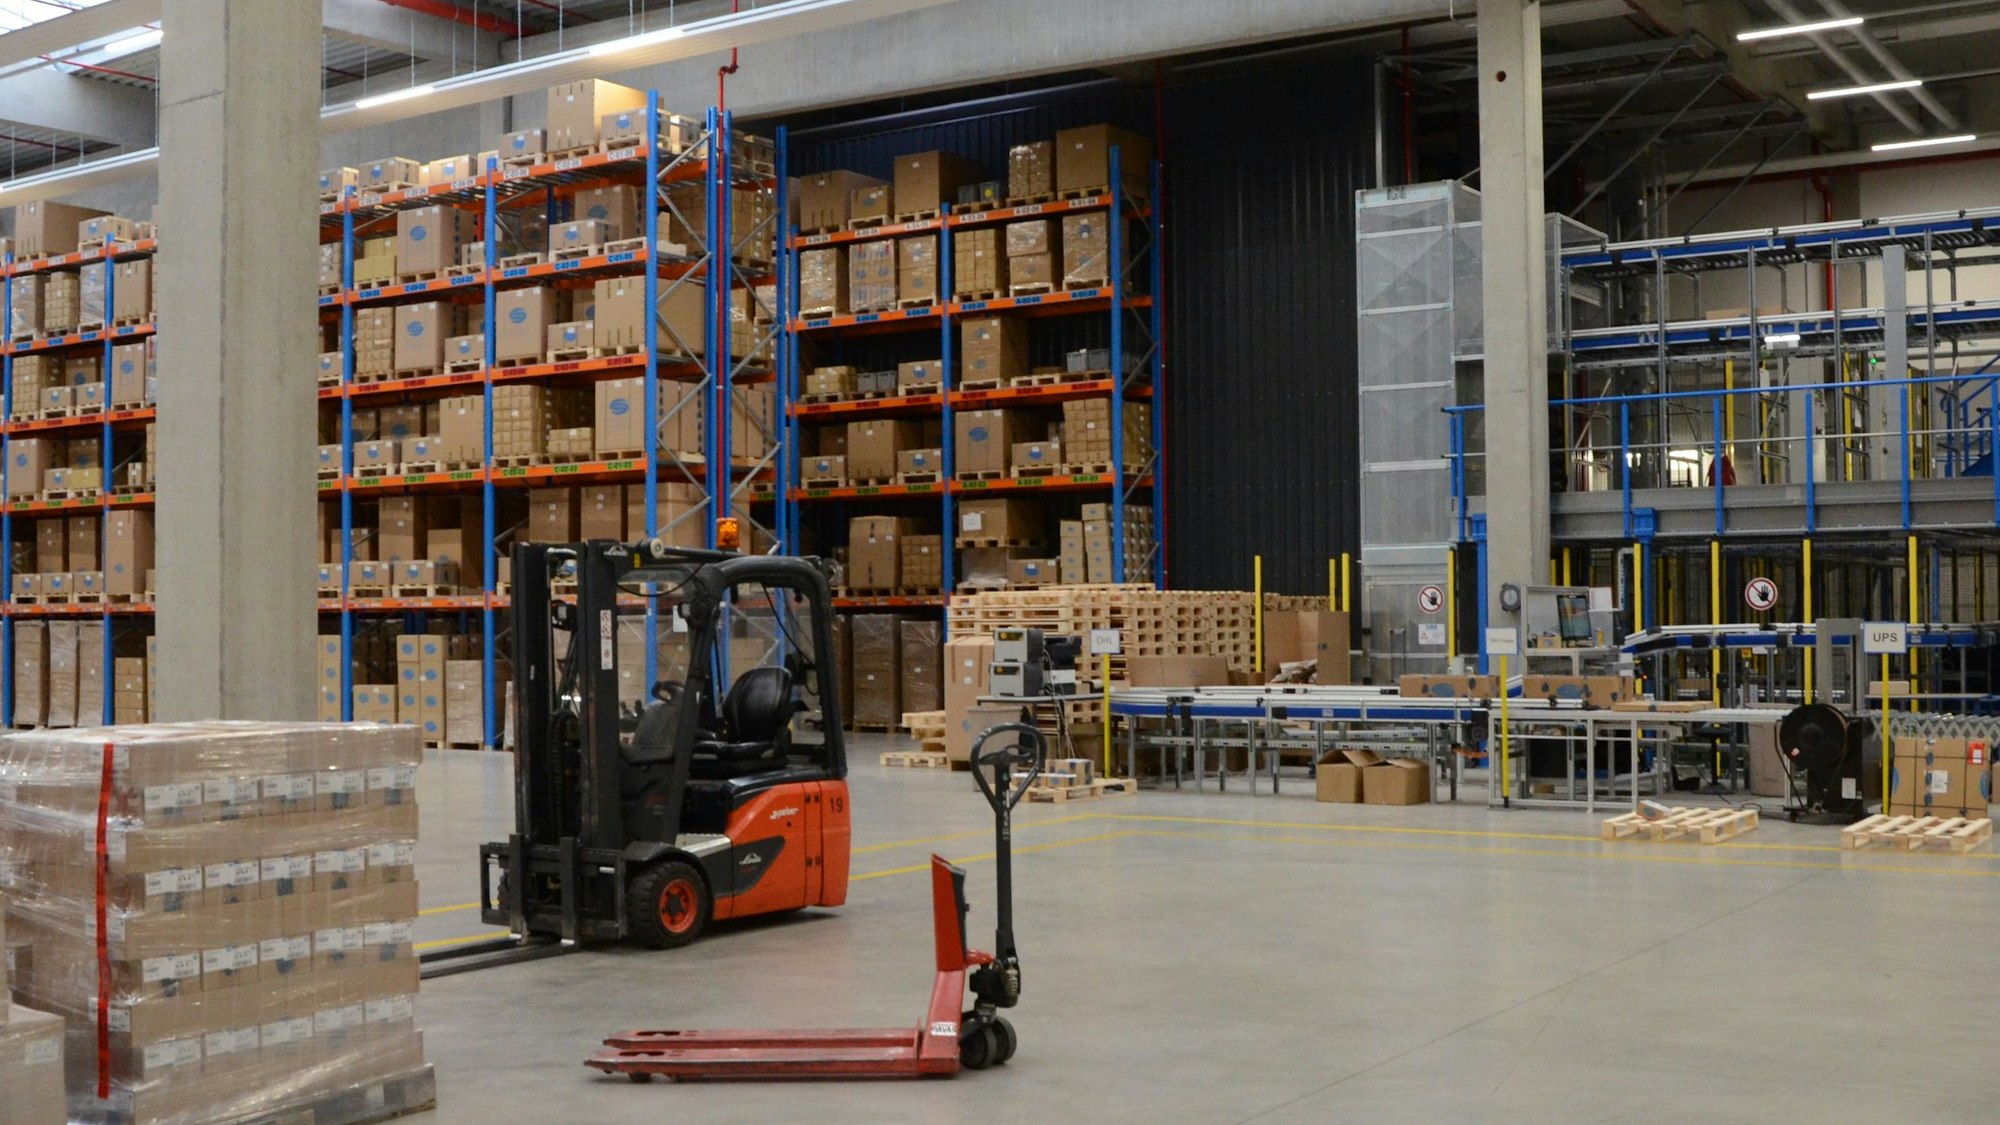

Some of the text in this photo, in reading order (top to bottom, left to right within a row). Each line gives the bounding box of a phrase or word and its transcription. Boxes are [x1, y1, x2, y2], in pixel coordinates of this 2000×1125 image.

[1097, 636, 1112, 645] DHL
[1873, 632, 1898, 643] UPS
[831, 797, 843, 813] 19
